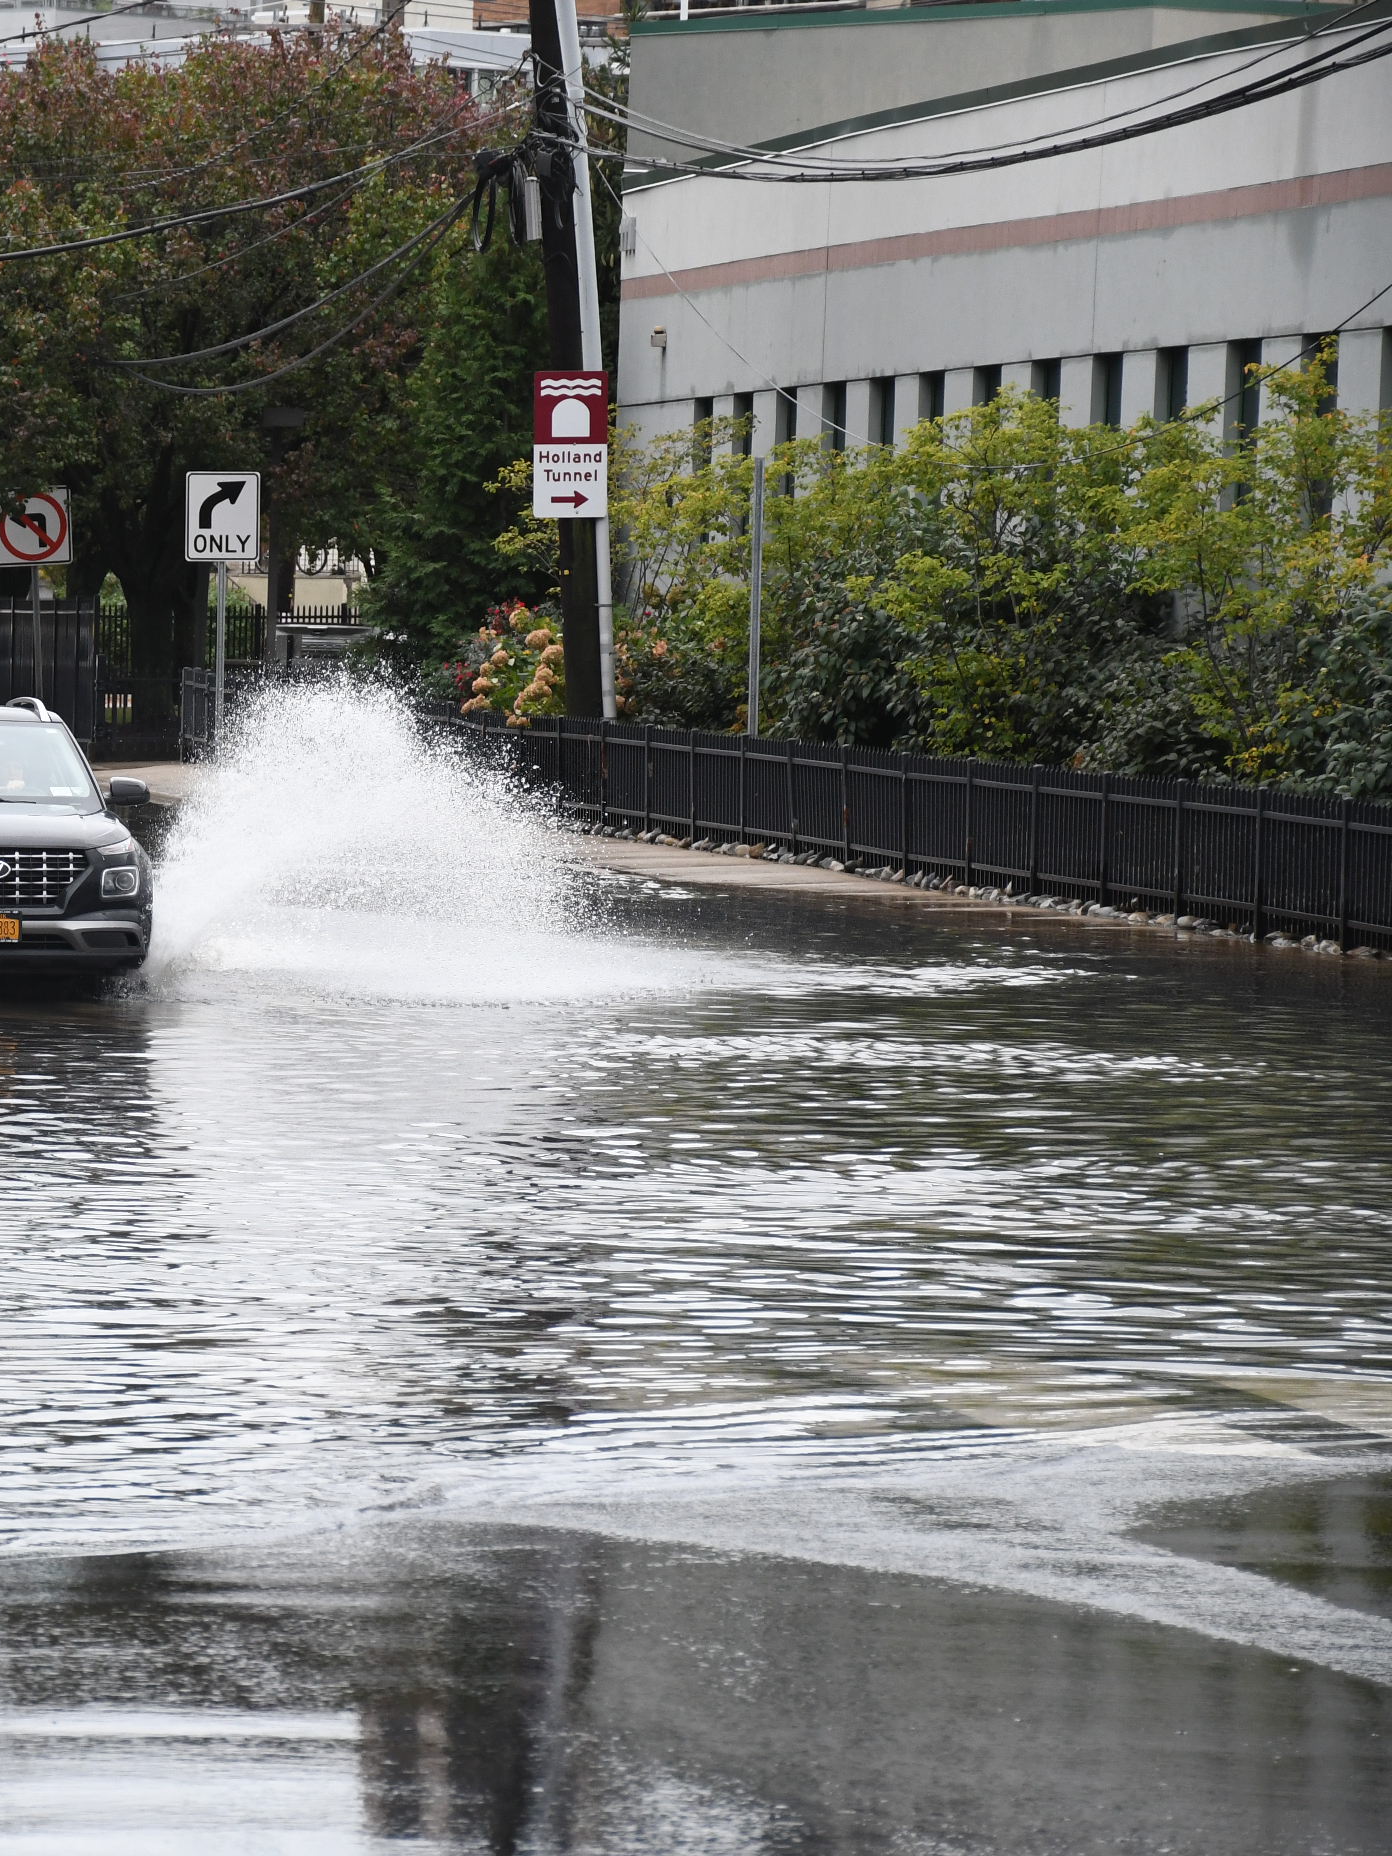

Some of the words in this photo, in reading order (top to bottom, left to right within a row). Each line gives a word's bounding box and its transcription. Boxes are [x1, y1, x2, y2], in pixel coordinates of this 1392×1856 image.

[539, 450, 602, 464] Holland
[543, 469, 598, 482] Tunnel
[193, 534, 252, 553] ONLY
